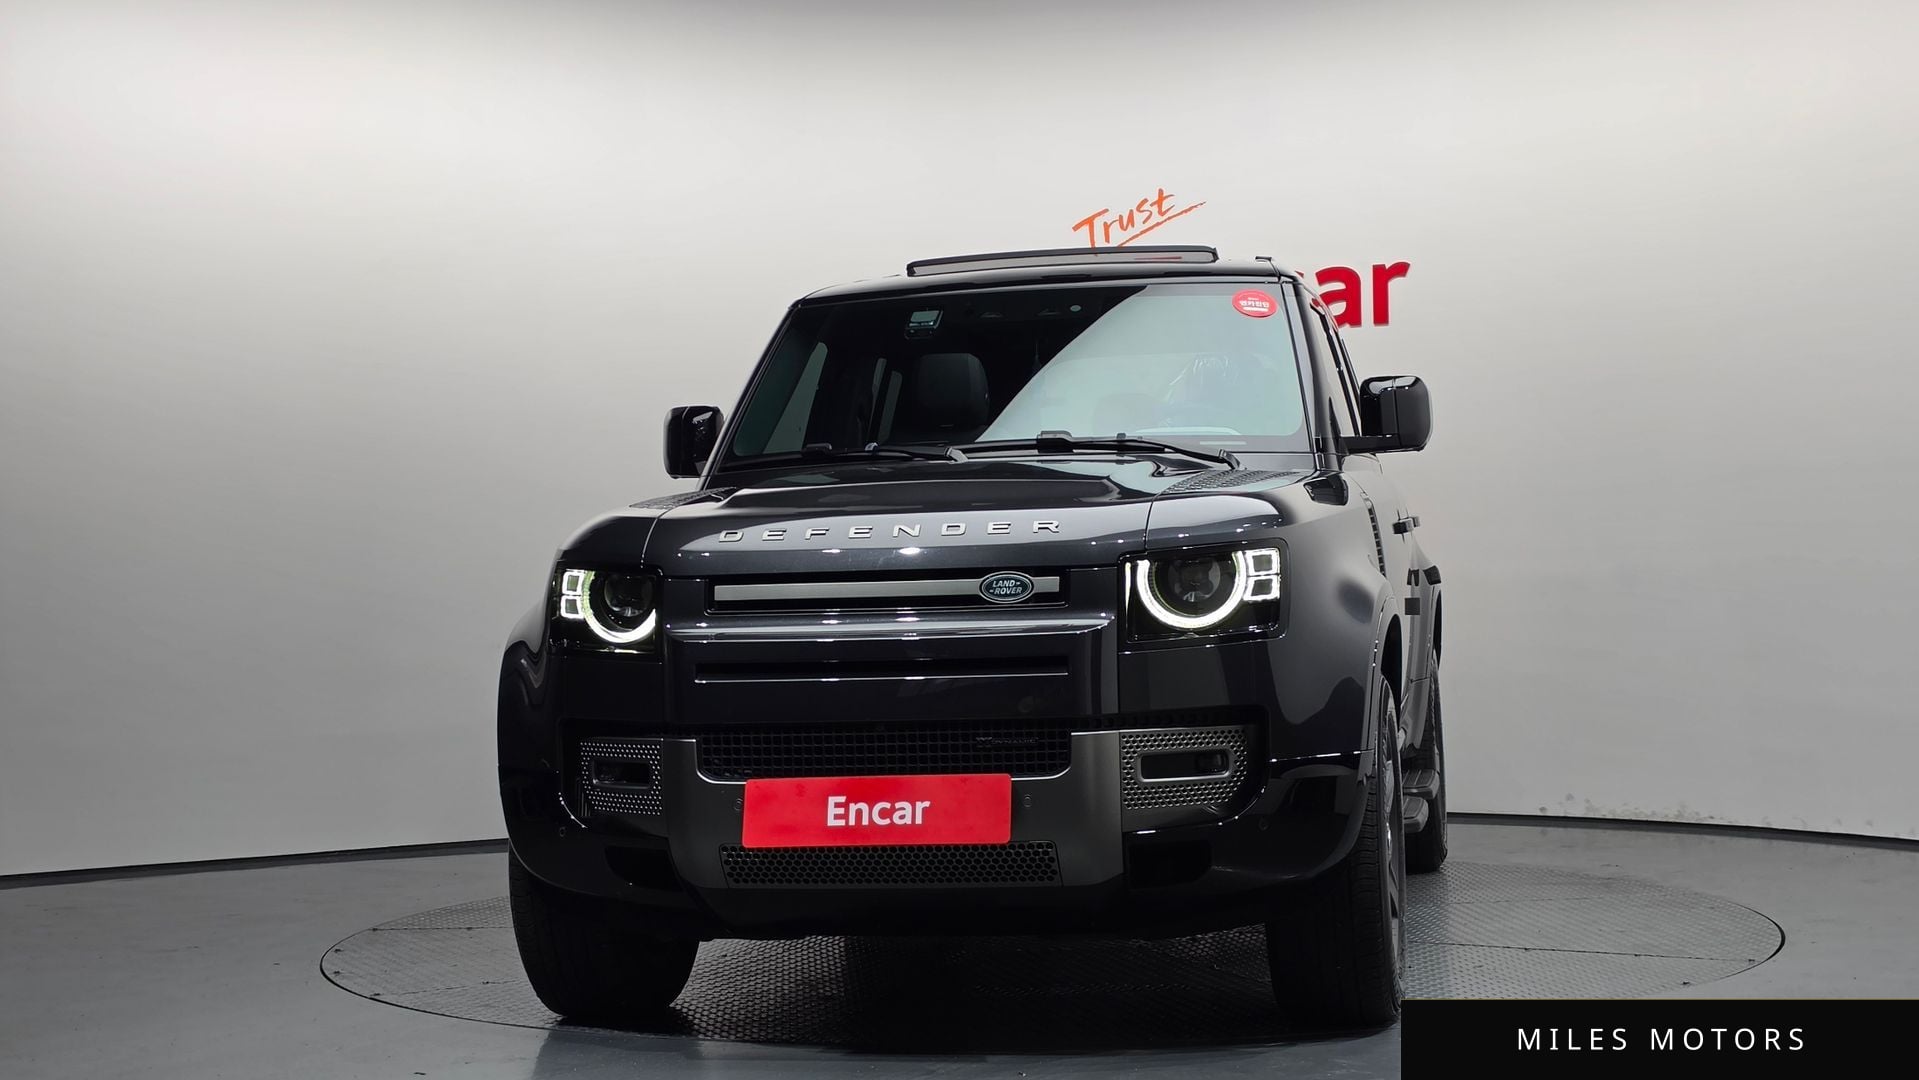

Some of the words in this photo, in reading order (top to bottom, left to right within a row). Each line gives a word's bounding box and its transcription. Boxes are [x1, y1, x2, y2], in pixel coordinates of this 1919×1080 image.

[1072, 188, 1175, 248] Trust
[1296, 261, 1411, 328] ar
[718, 519, 1060, 543] DEFENDER
[827, 795, 931, 827] Encar
